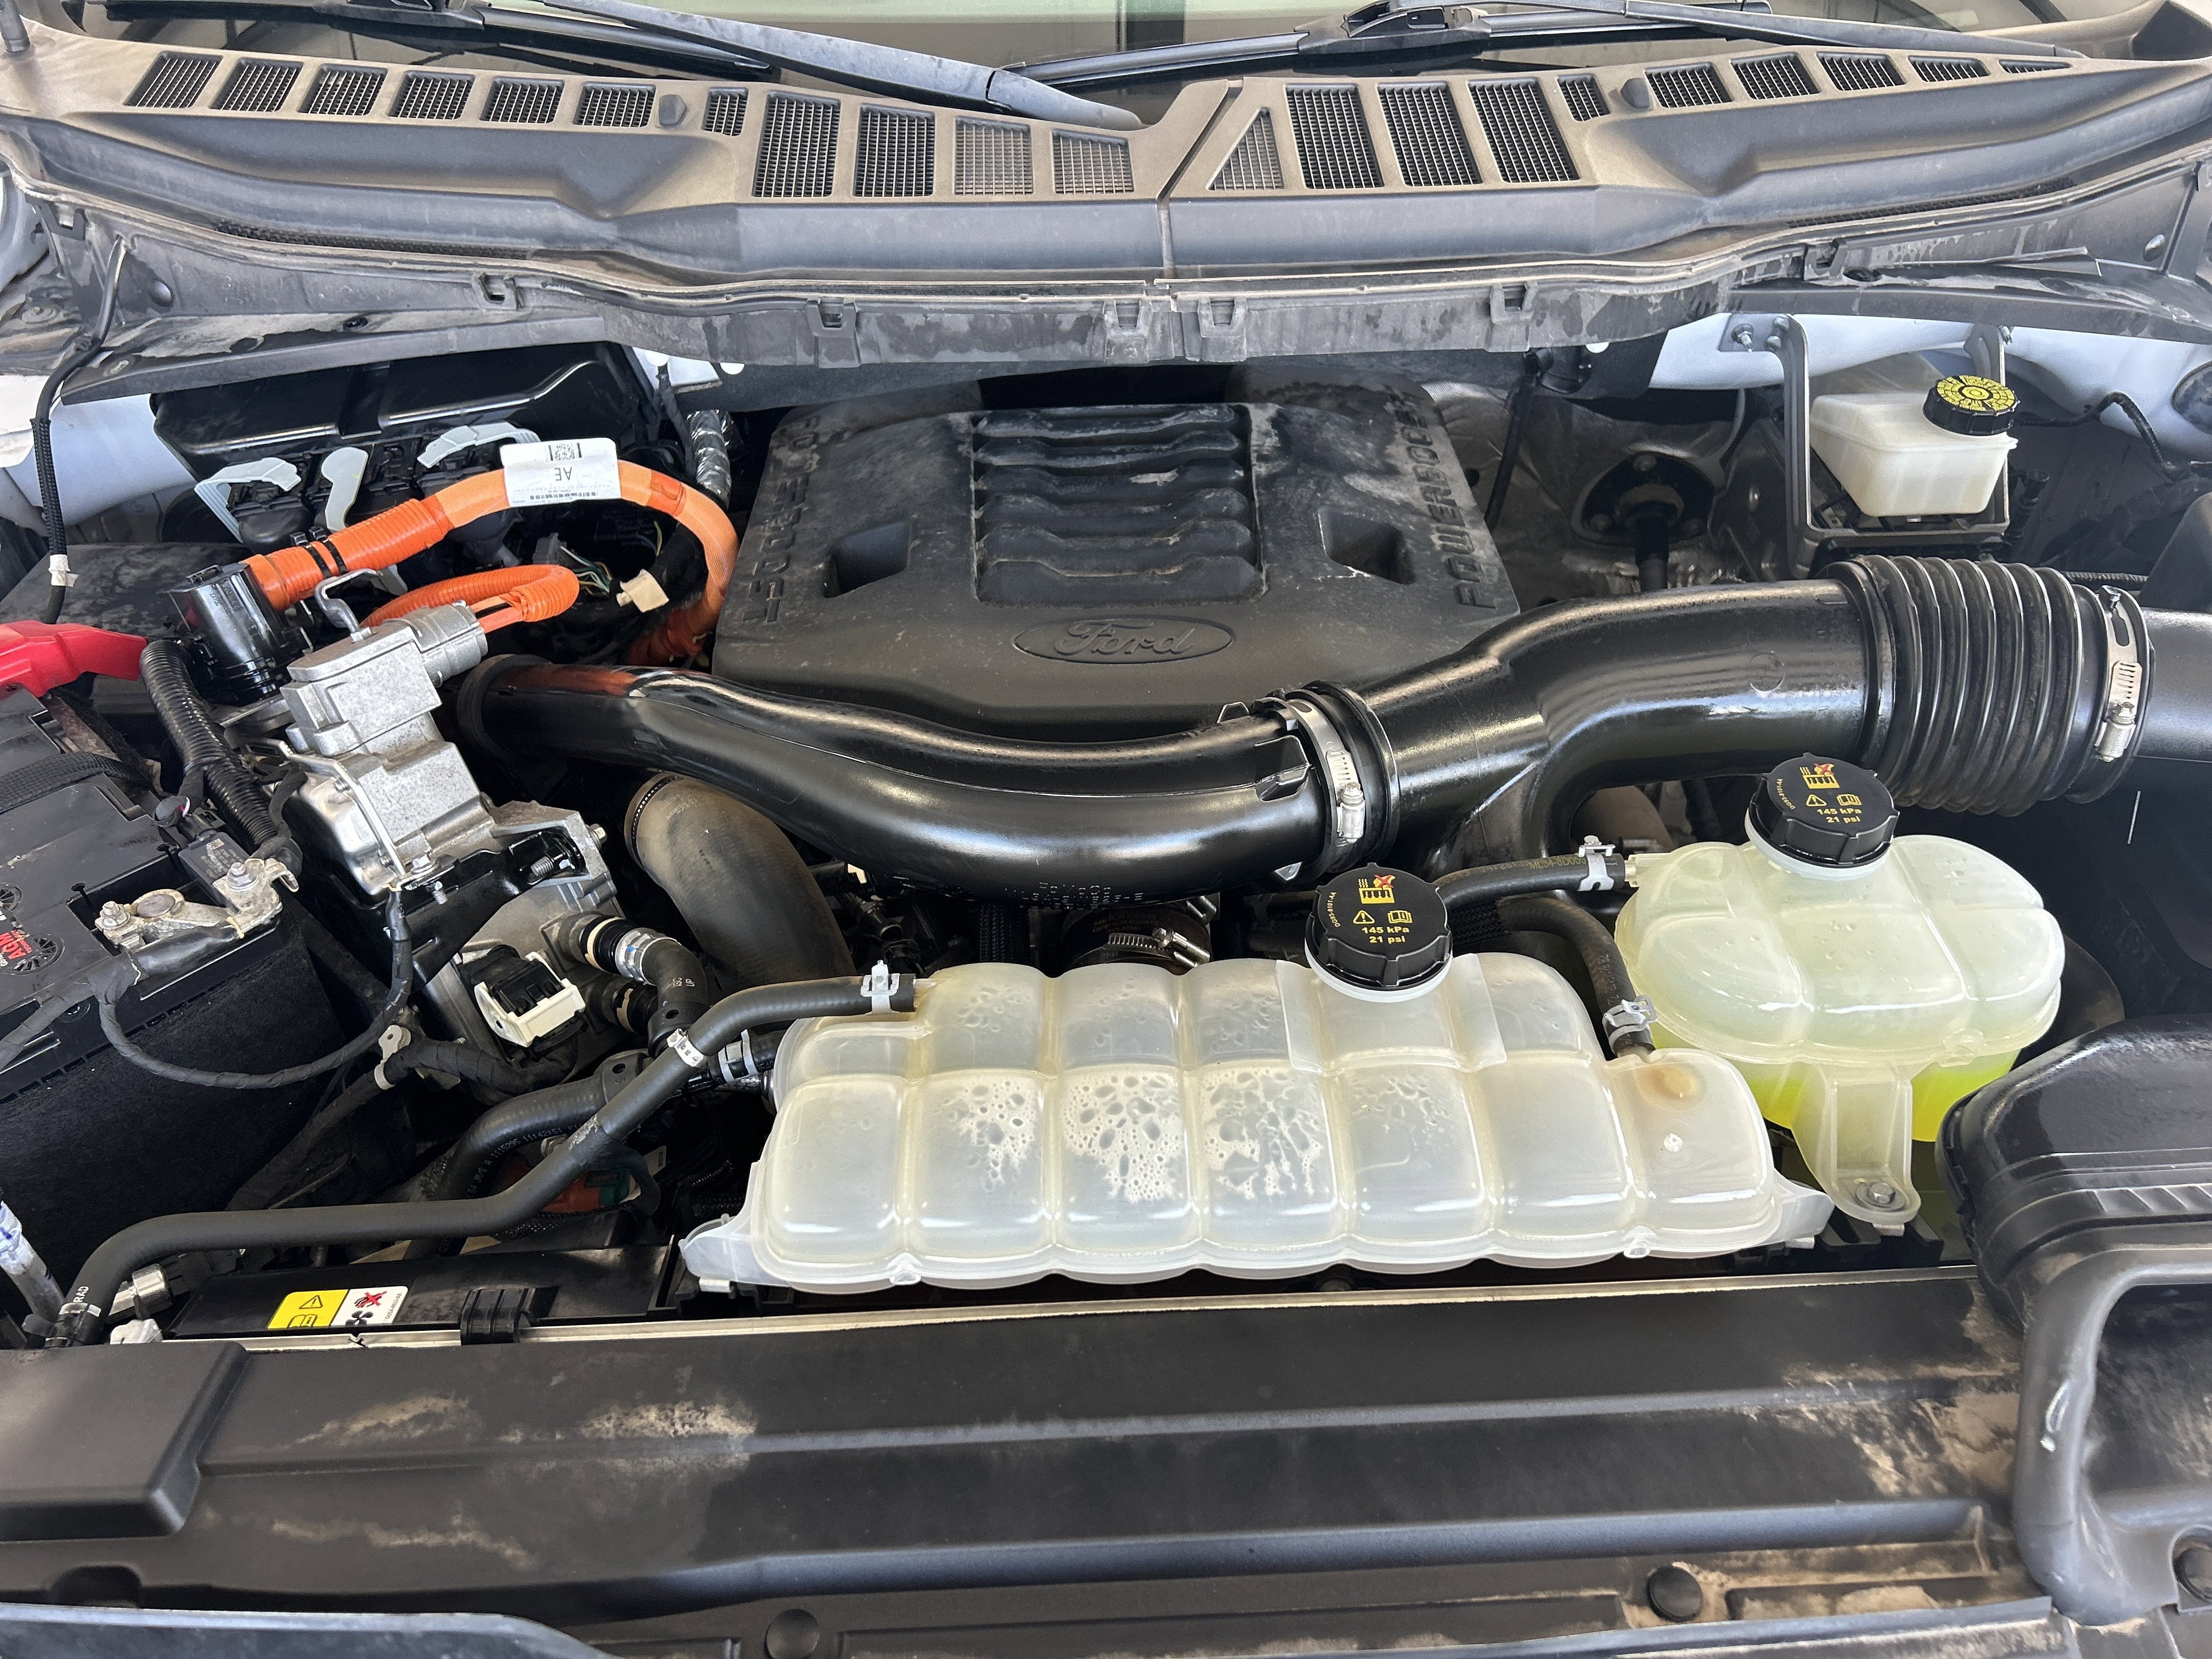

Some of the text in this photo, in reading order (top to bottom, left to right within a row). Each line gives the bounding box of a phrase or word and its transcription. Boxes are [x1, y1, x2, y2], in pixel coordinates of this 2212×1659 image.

[555, 466, 572, 481] AE
[1054, 618, 1196, 655] Ford
[1843, 816, 1861, 824] psi
[1387, 935, 1406, 944] psi
[73, 1286, 89, 1302] RAD
